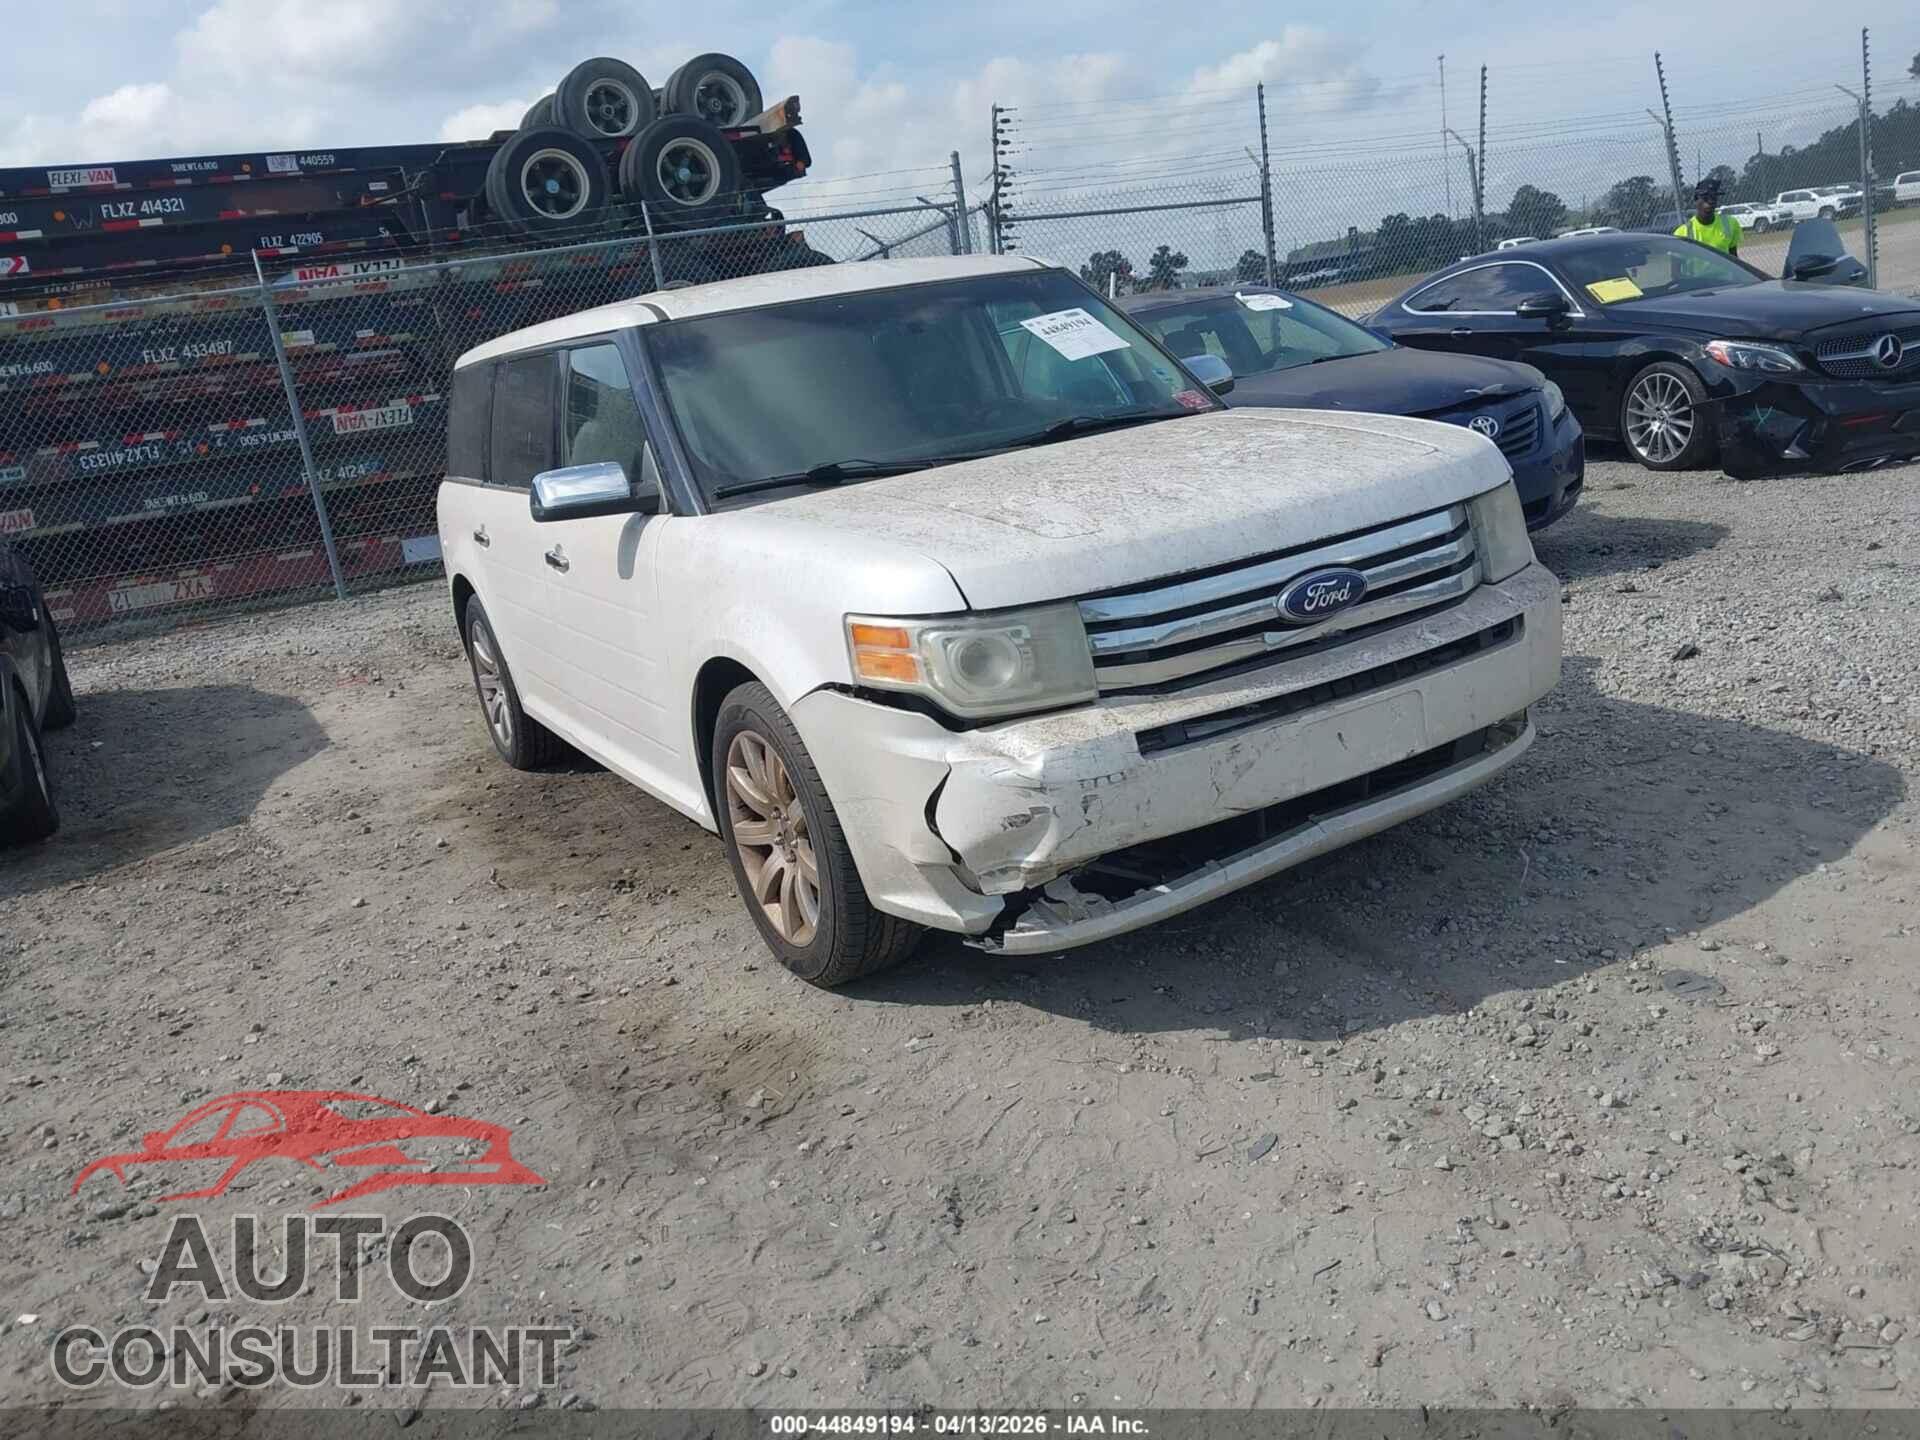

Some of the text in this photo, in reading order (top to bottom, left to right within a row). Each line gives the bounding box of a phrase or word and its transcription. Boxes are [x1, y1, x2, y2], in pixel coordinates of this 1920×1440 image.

[101, 197, 185, 218] FLXZ 414321
[261, 234, 284, 248] FLXZ
[143, 340, 233, 364] FLXZ 433487
[300, 468, 333, 486] FXZ
[1304, 578, 1351, 611] Ford
